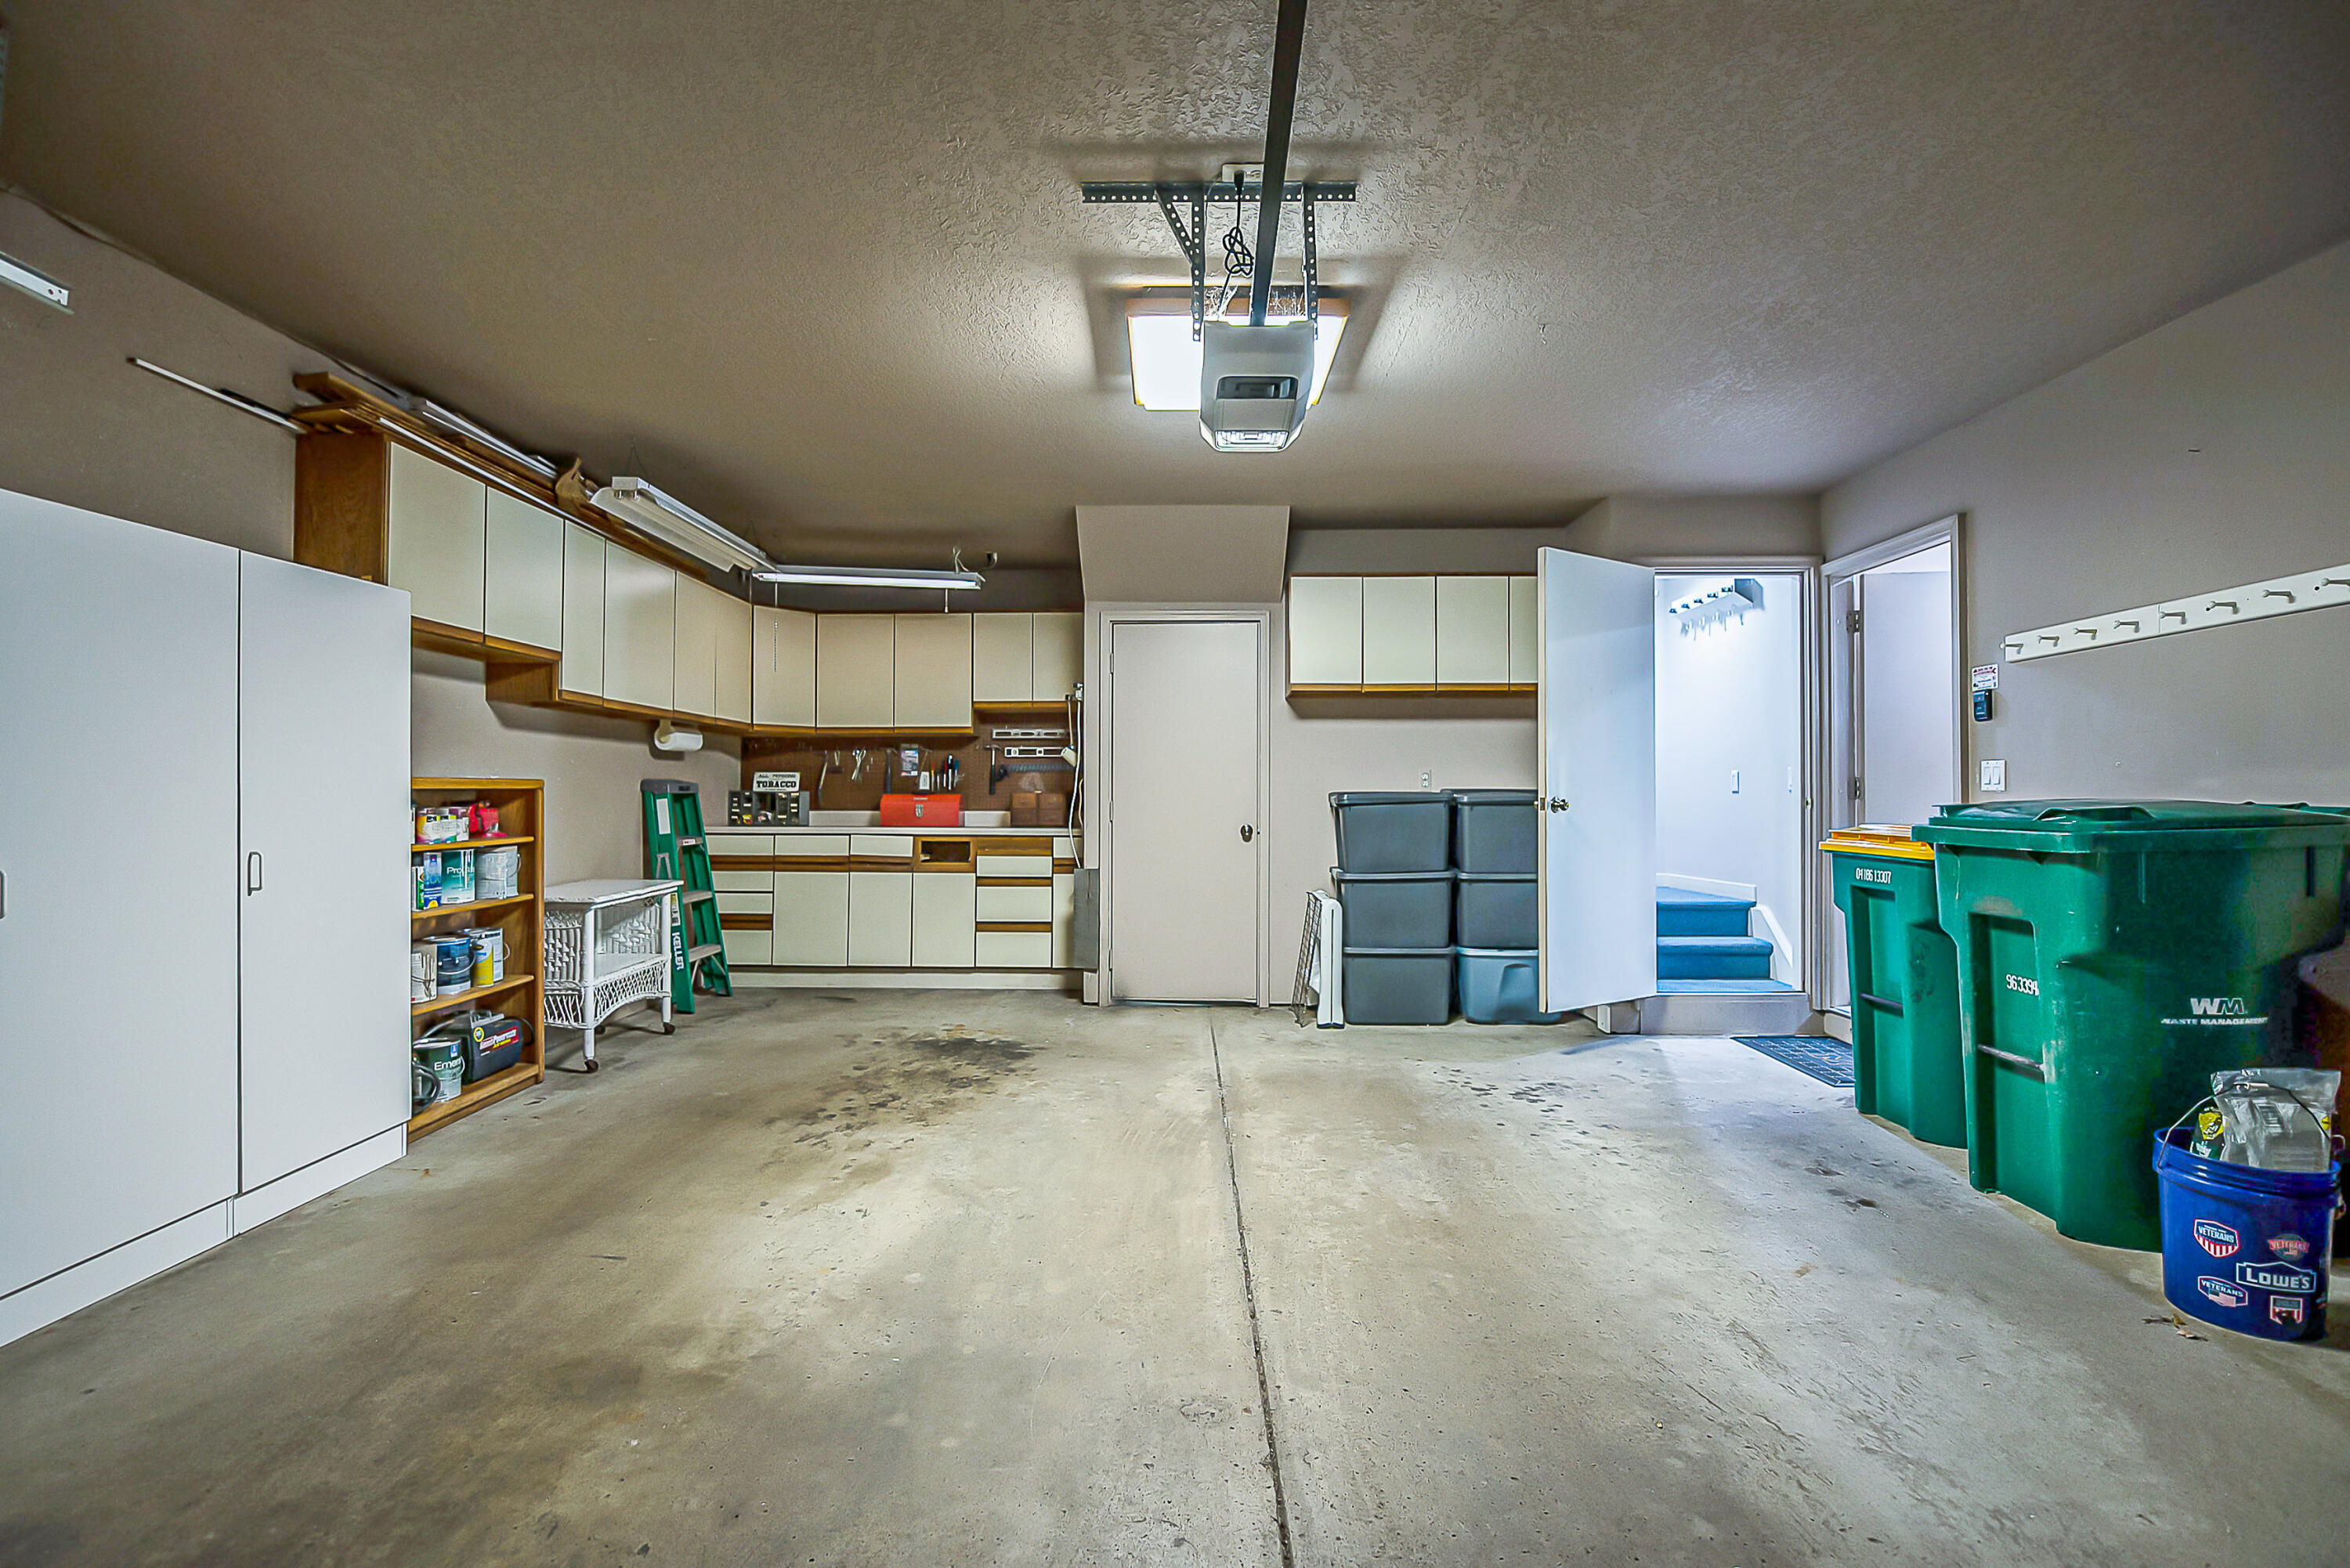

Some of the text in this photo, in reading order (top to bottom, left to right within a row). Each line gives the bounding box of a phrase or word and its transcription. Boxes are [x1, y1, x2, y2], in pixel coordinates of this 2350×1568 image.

[671, 931, 685, 970] KELLER
[2200, 1017, 2269, 1025] MANAGEMENT
[2198, 1226, 2235, 1244] VETERANS
[2246, 1267, 2311, 1289] LOWE'S
[2200, 1279, 2244, 1298] VETERANS
